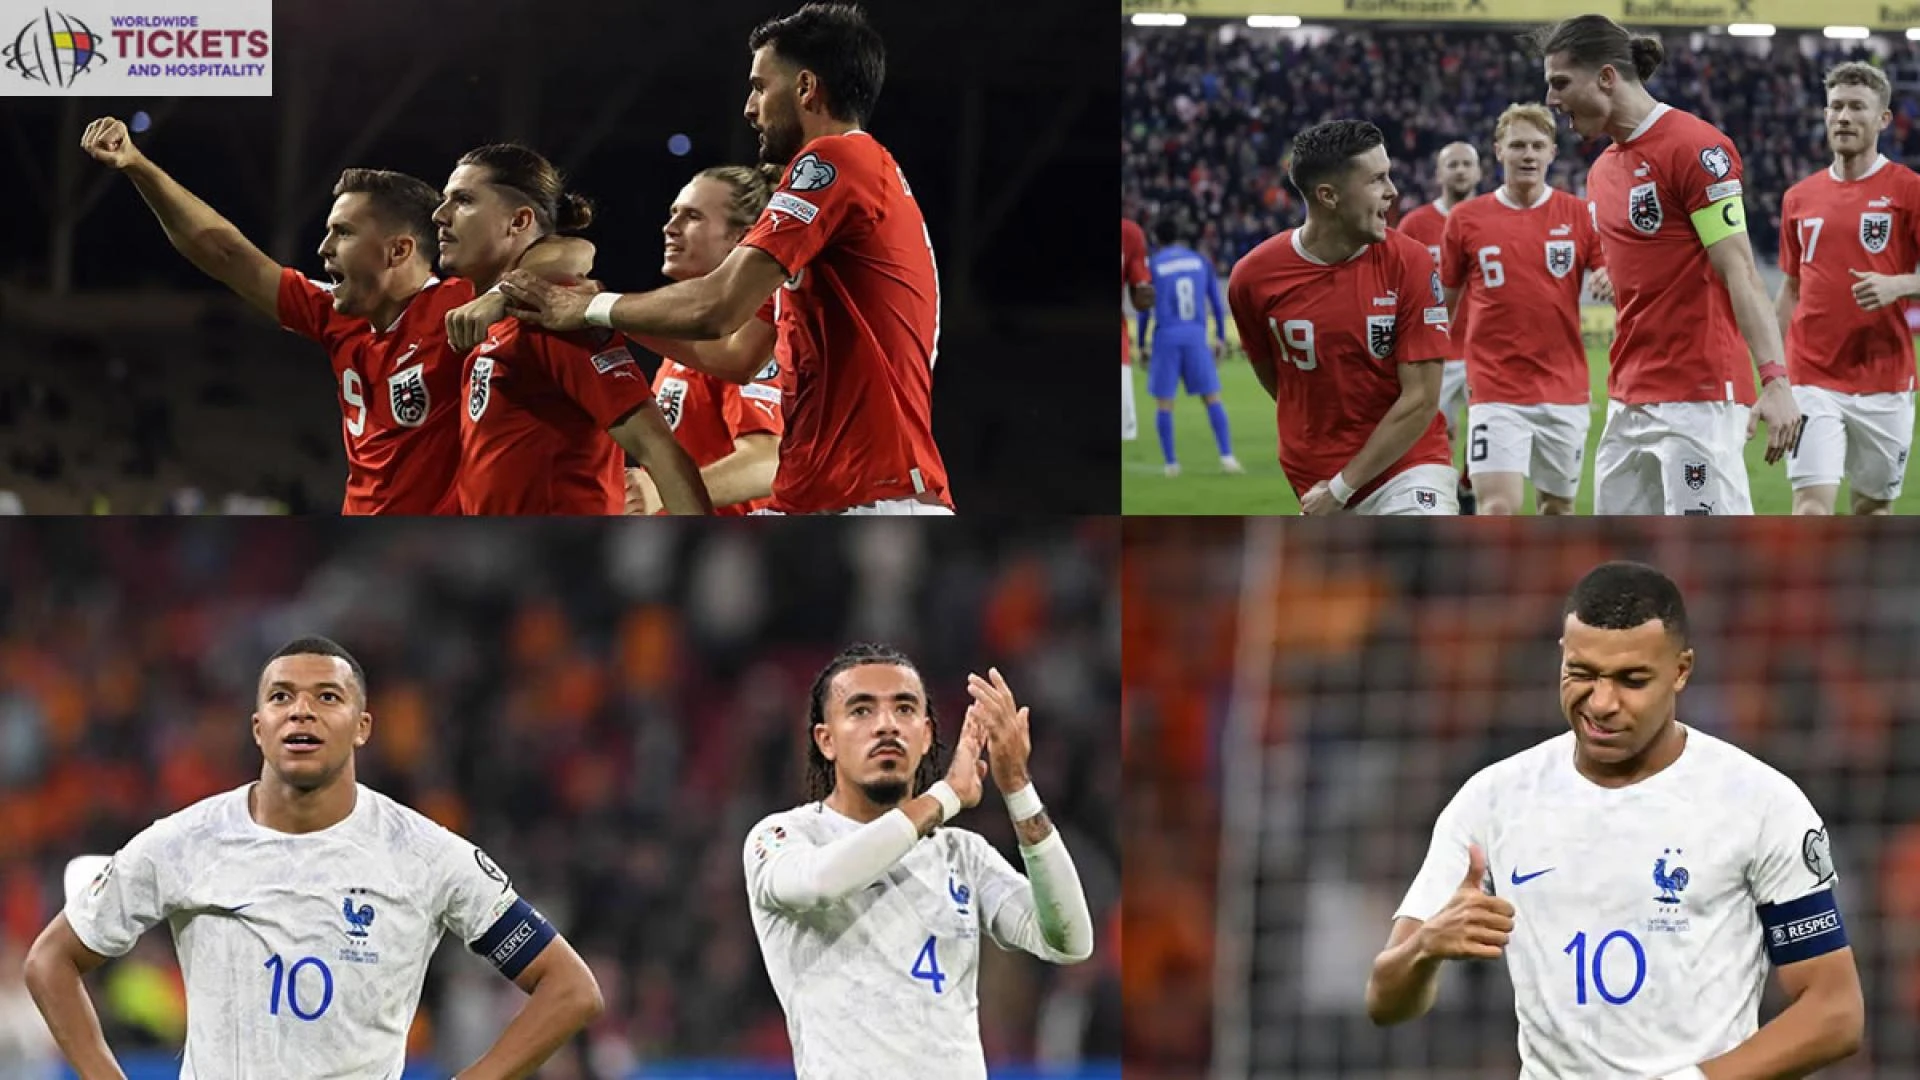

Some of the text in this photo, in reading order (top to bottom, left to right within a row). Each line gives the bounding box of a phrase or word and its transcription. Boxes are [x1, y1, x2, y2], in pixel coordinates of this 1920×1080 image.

[1478, 245, 1505, 288] 6
[1176, 277, 1196, 321] 8
[1268, 316, 1317, 371] 19
[343, 367, 367, 437] 9
[1471, 423, 1489, 461] 6
[495, 921, 533, 961] RESPECT
[1788, 913, 1838, 938] RESPECT
[263, 952, 334, 1021] 10
[911, 936, 945, 993] 4
[1563, 929, 1646, 1006] 10
